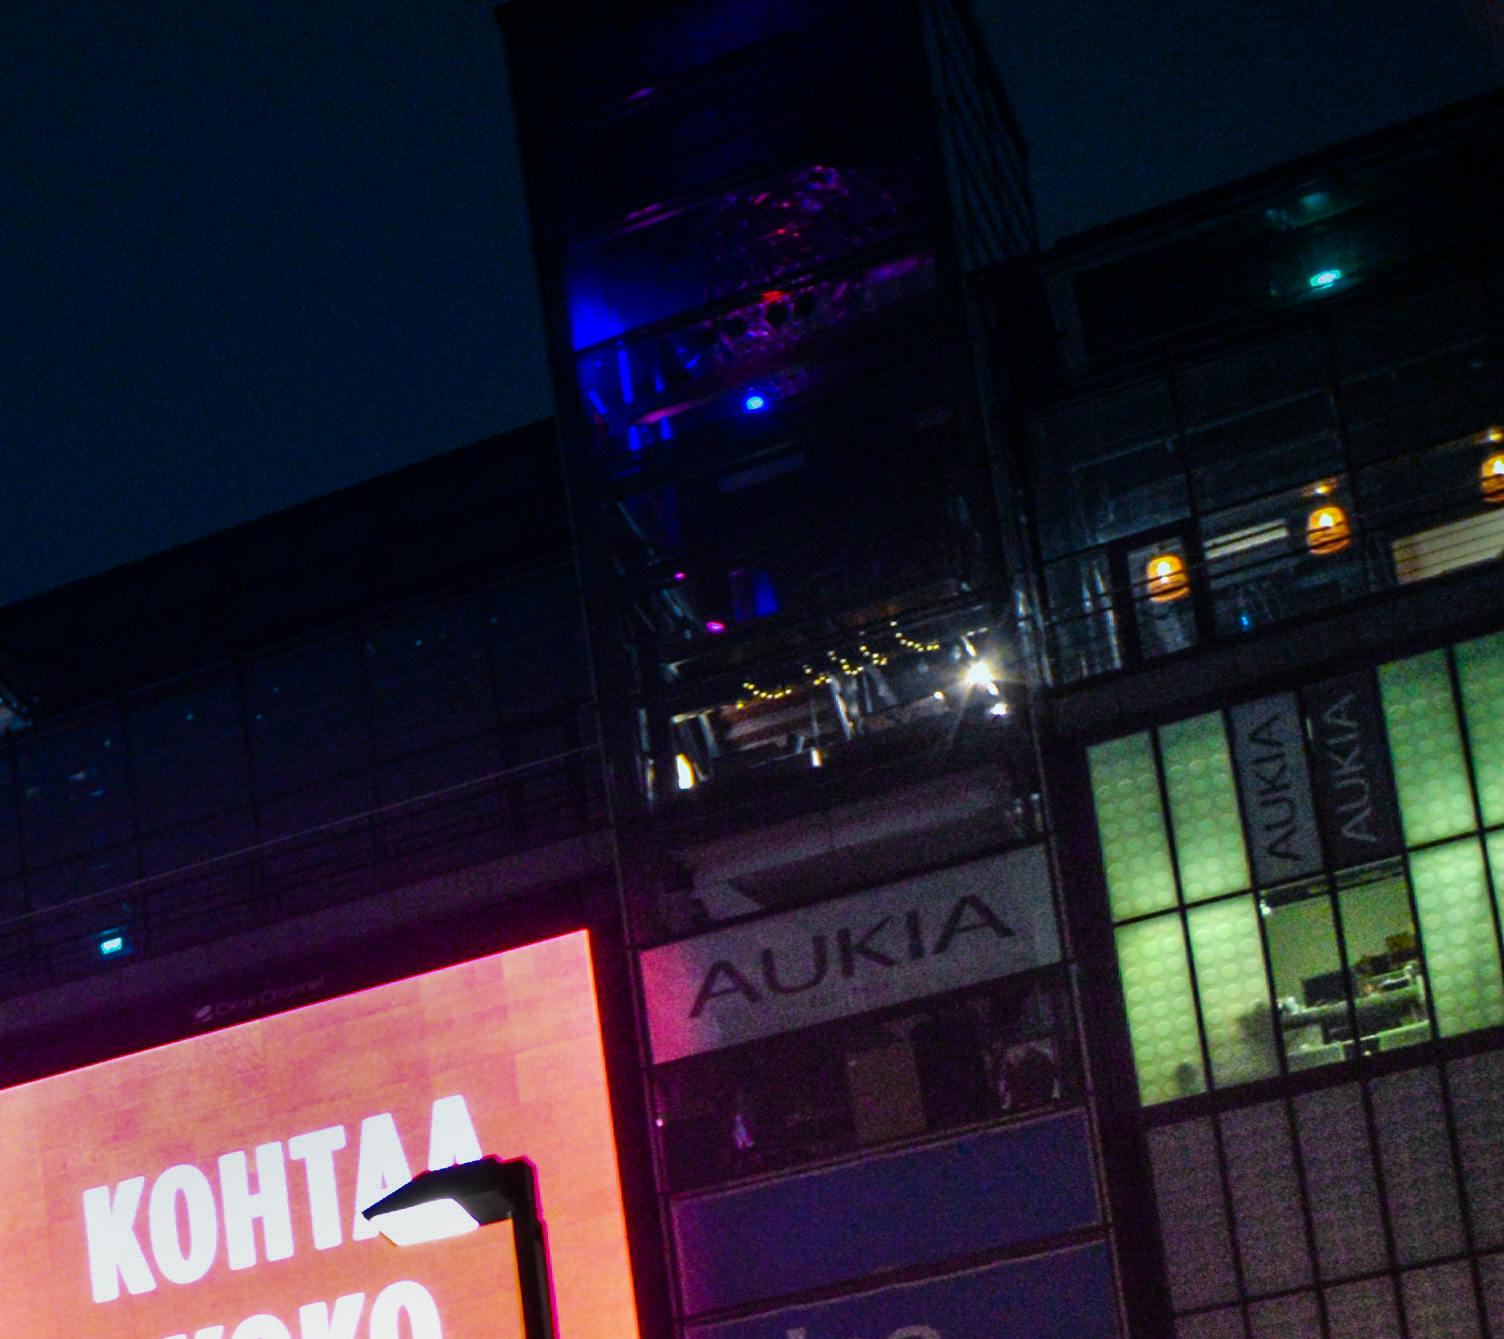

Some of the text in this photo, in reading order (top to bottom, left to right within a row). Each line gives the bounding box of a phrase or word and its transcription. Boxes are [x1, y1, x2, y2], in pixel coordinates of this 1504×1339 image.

[1249, 713, 1303, 863] AUKIA
[1325, 691, 1379, 845] AUKIA
[688, 893, 1016, 1018] AUKIA
